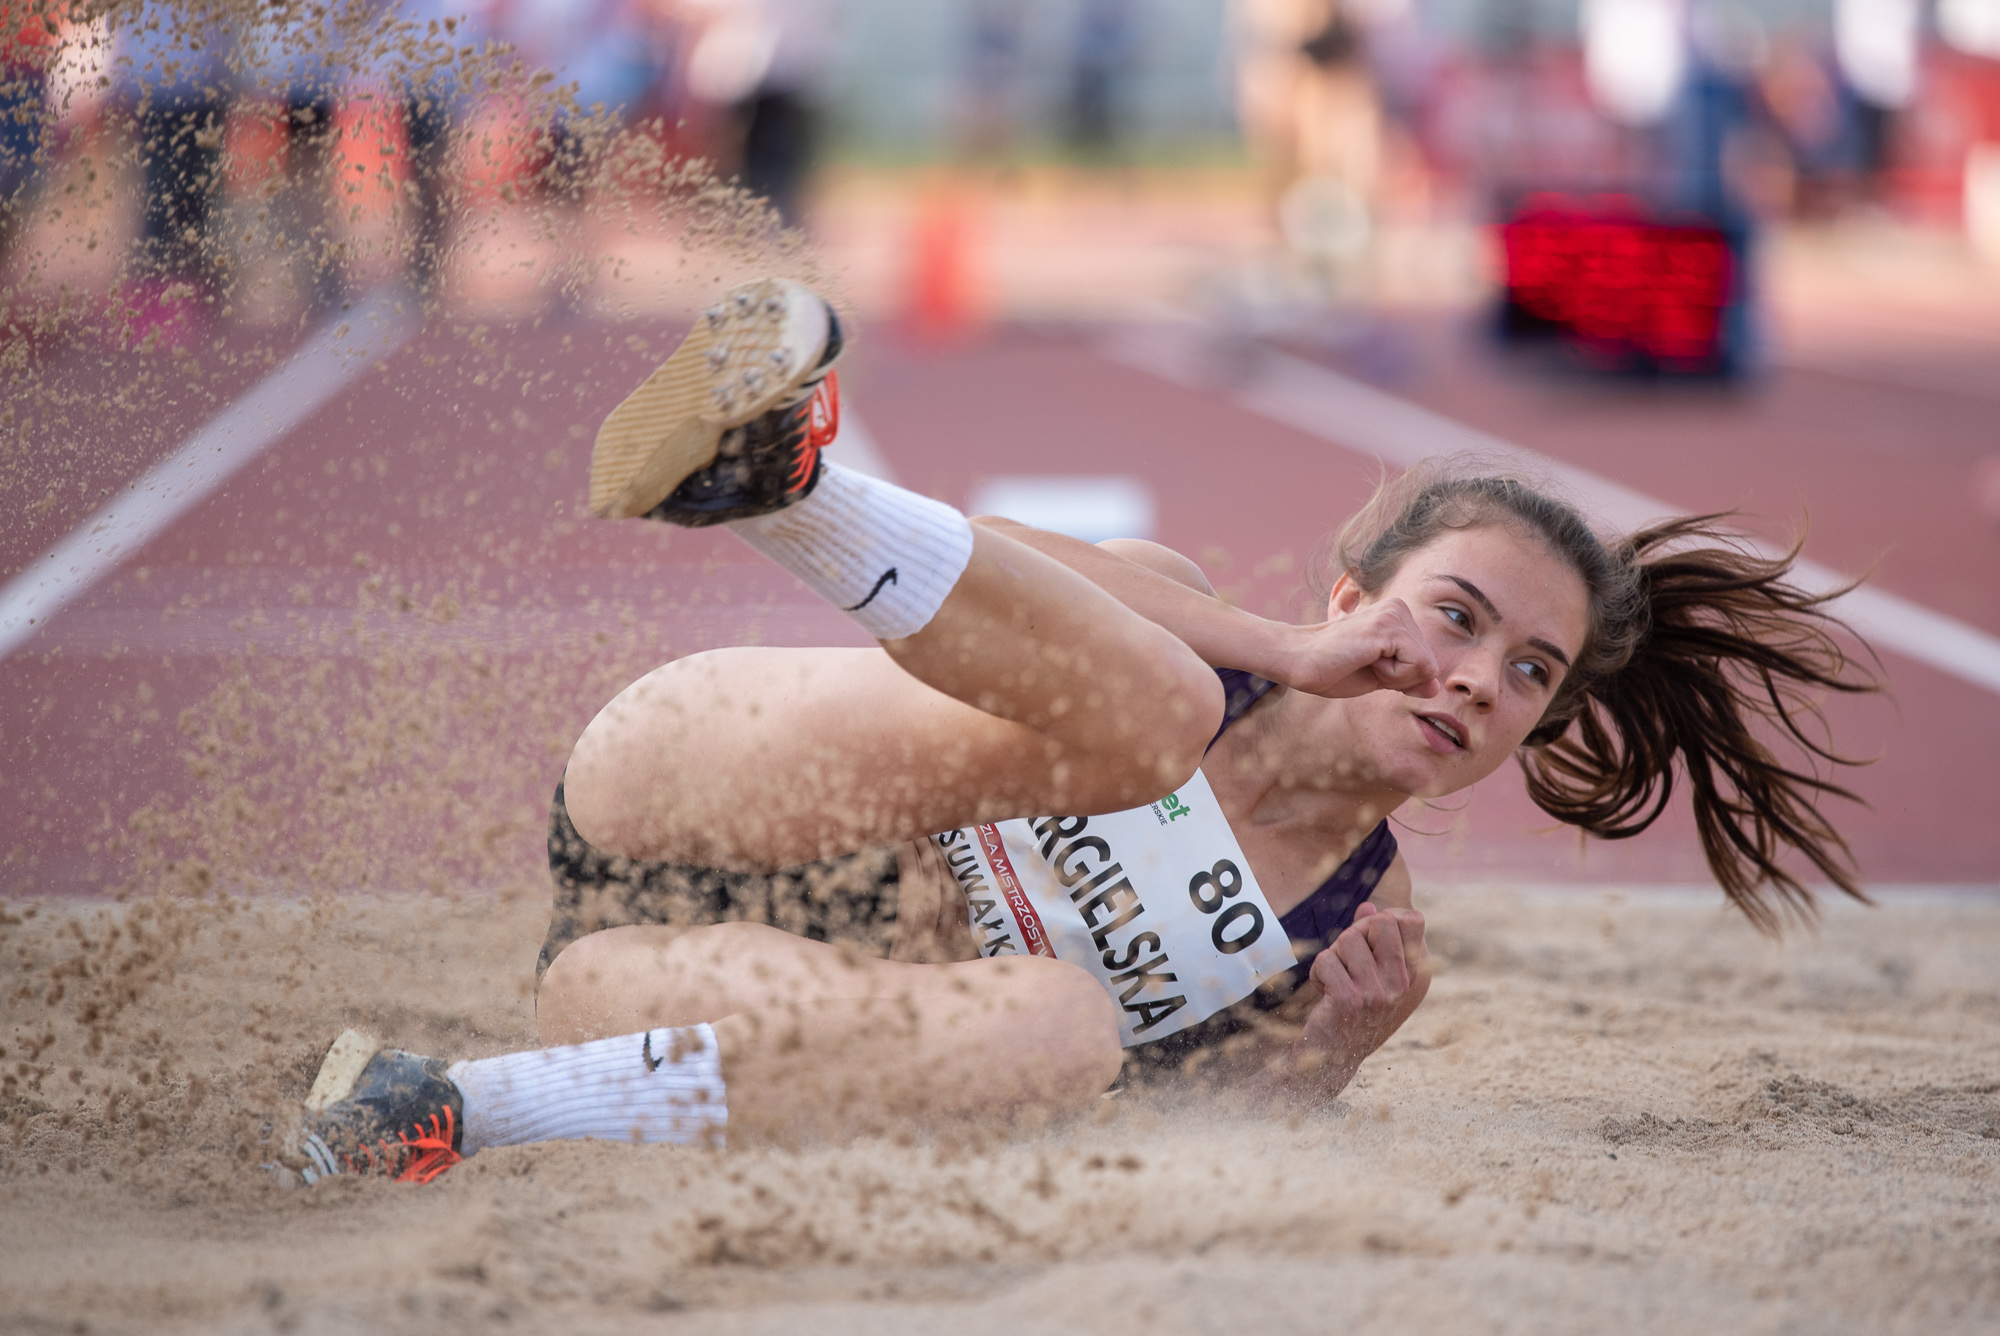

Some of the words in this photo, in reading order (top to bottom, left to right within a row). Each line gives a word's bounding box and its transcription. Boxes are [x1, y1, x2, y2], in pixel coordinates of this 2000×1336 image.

[1161, 793, 1191, 822] et
[938, 829, 1018, 957] SUWAŁK
[1028, 816, 1188, 1036] RGIELSKA
[1188, 858, 1265, 955] 80
